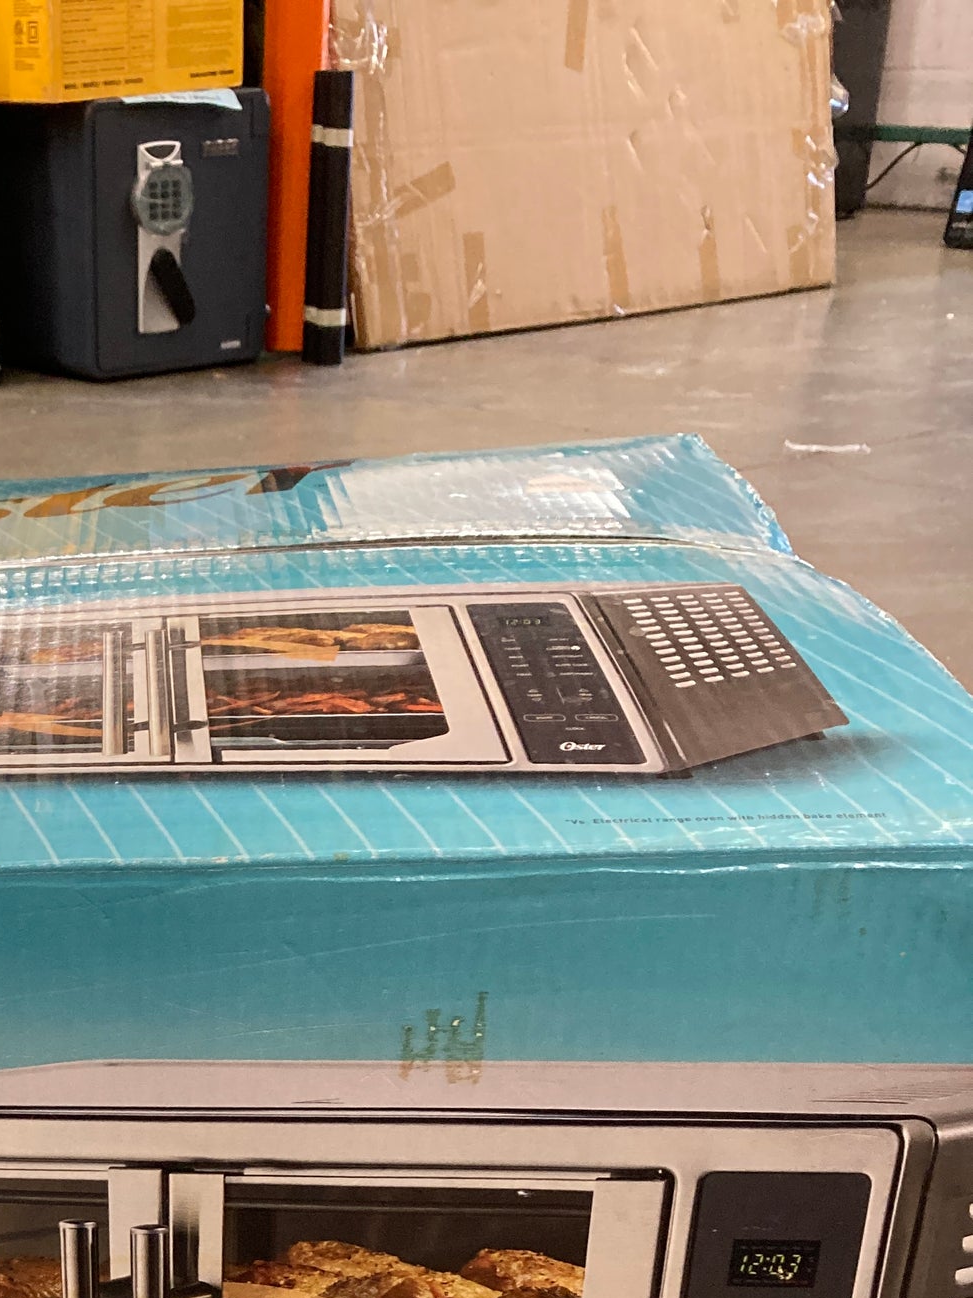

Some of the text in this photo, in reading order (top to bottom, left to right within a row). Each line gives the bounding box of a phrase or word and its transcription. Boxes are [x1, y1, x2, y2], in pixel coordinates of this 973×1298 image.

[559, 741, 606, 752] Oster
[592, 816, 652, 825] Electrical
[656, 816, 691, 827] range
[695, 815, 724, 823] oven
[728, 812, 755, 822] with
[758, 811, 800, 821] hidden
[803, 811, 832, 820] bake
[836, 811, 887, 820] element
